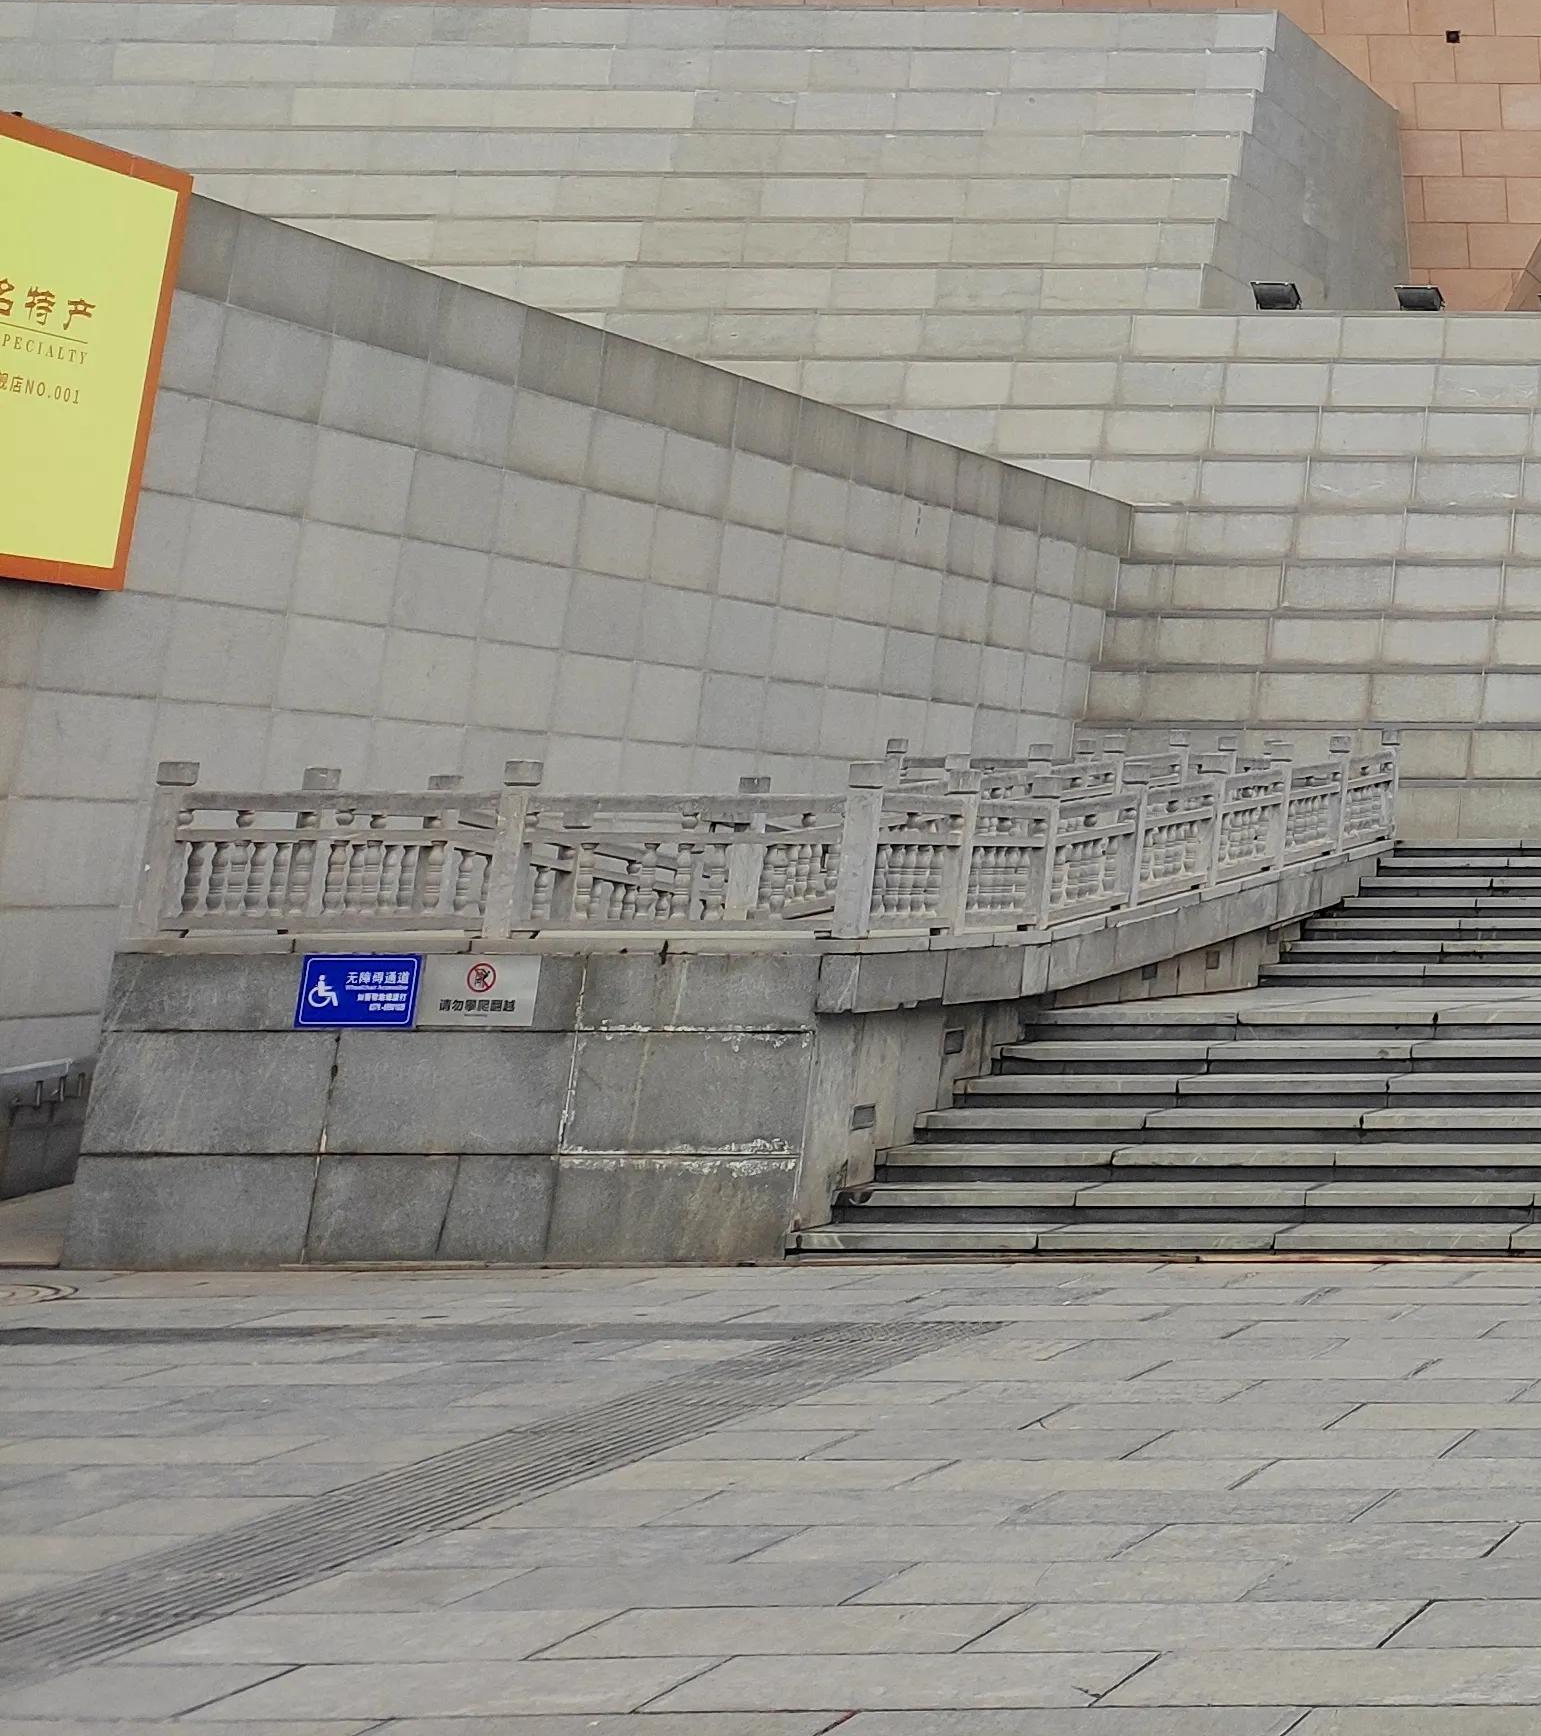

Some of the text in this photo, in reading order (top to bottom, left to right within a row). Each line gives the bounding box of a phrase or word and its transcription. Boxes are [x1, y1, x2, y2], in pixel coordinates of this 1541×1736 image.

[345, 971, 410, 984] 无障碍通道
